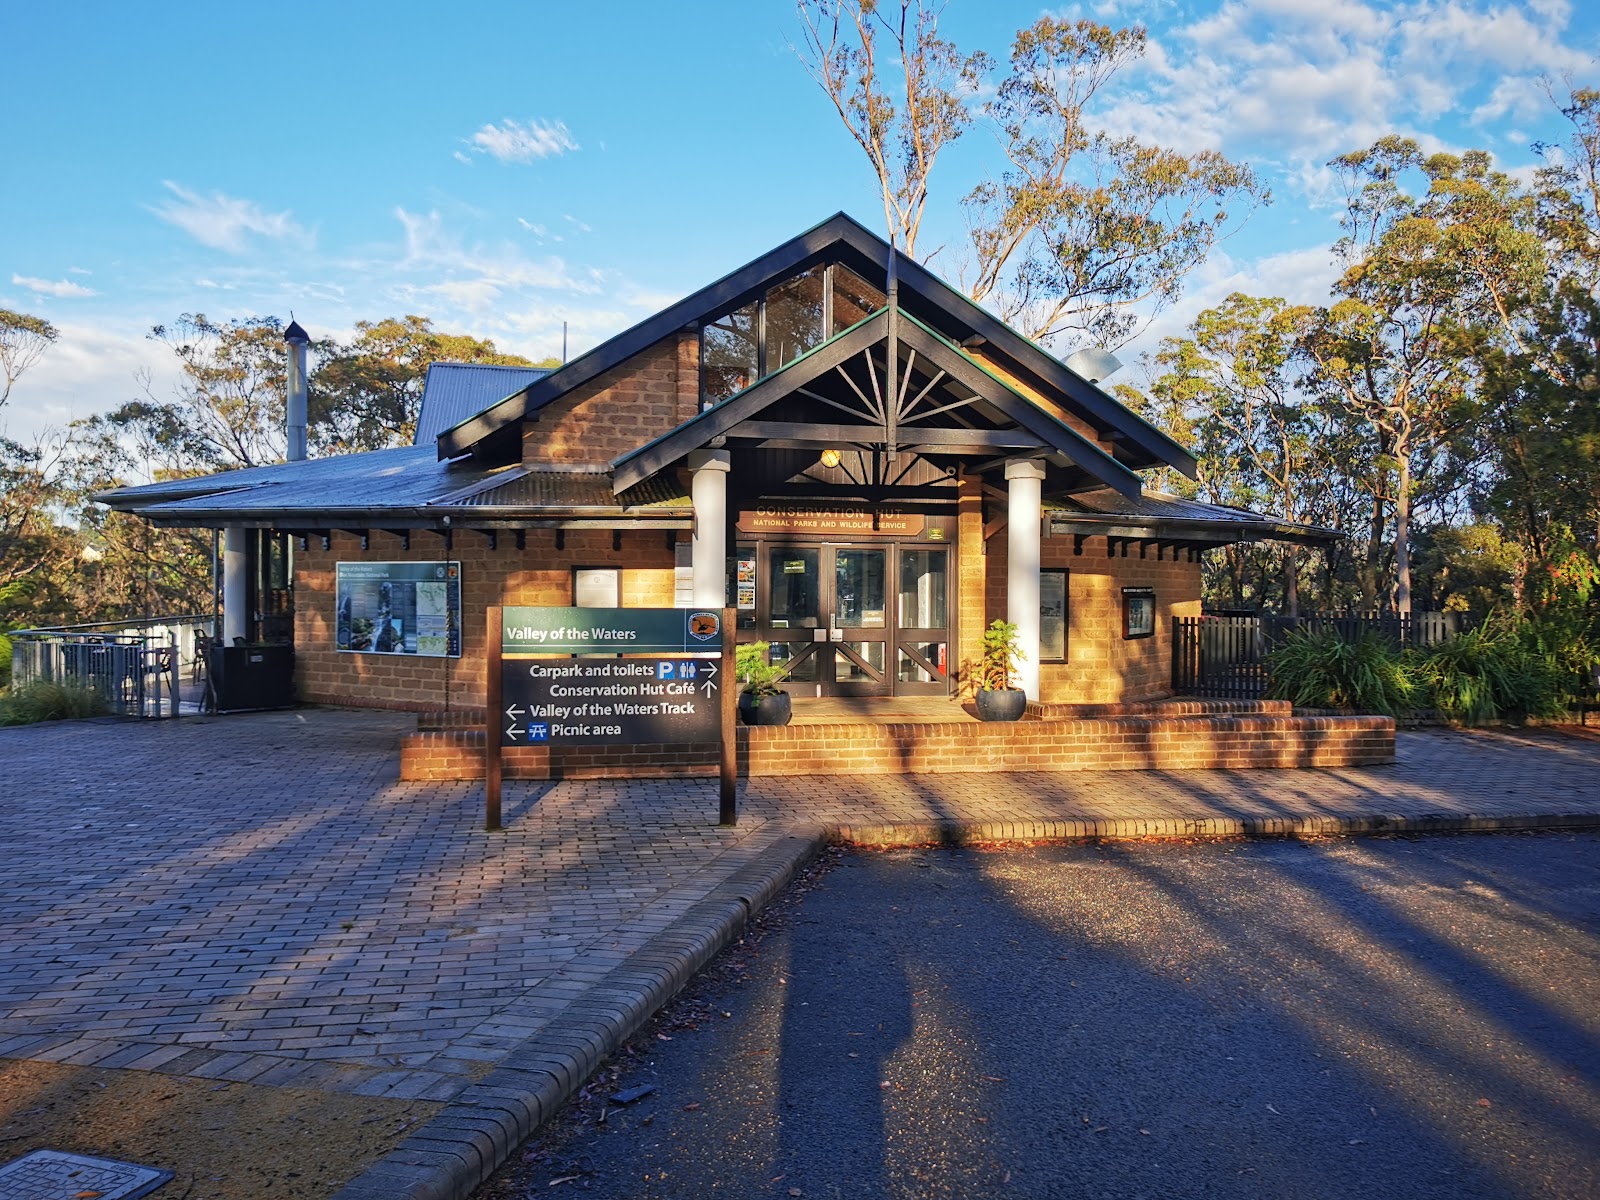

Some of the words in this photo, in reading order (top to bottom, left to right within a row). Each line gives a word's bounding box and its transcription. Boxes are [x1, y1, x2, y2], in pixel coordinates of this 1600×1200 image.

[757, 506, 865, 519] CONSERVATION
[875, 508, 903, 519] HUT
[753, 519, 790, 527] NATIONAL
[839, 521, 873, 529] WILDLIFE
[507, 627, 548, 643] Valley
[550, 627, 565, 640] of
[567, 627, 589, 640] the
[591, 627, 636, 640] Waters
[530, 664, 583, 680] Carpark
[585, 664, 611, 677] and
[613, 663, 655, 677] toilets
[659, 662, 673, 678] P
[549, 683, 637, 698] Conservation
[640, 683, 664, 696] Hut
[666, 682, 695, 695] Café
[530, 704, 571, 720] Valley
[573, 704, 588, 716] of
[590, 703, 612, 716] the
[614, 703, 659, 715] Waters
[660, 702, 695, 714] Track
[551, 723, 590, 737] Picnic
[593, 724, 622, 735] area
